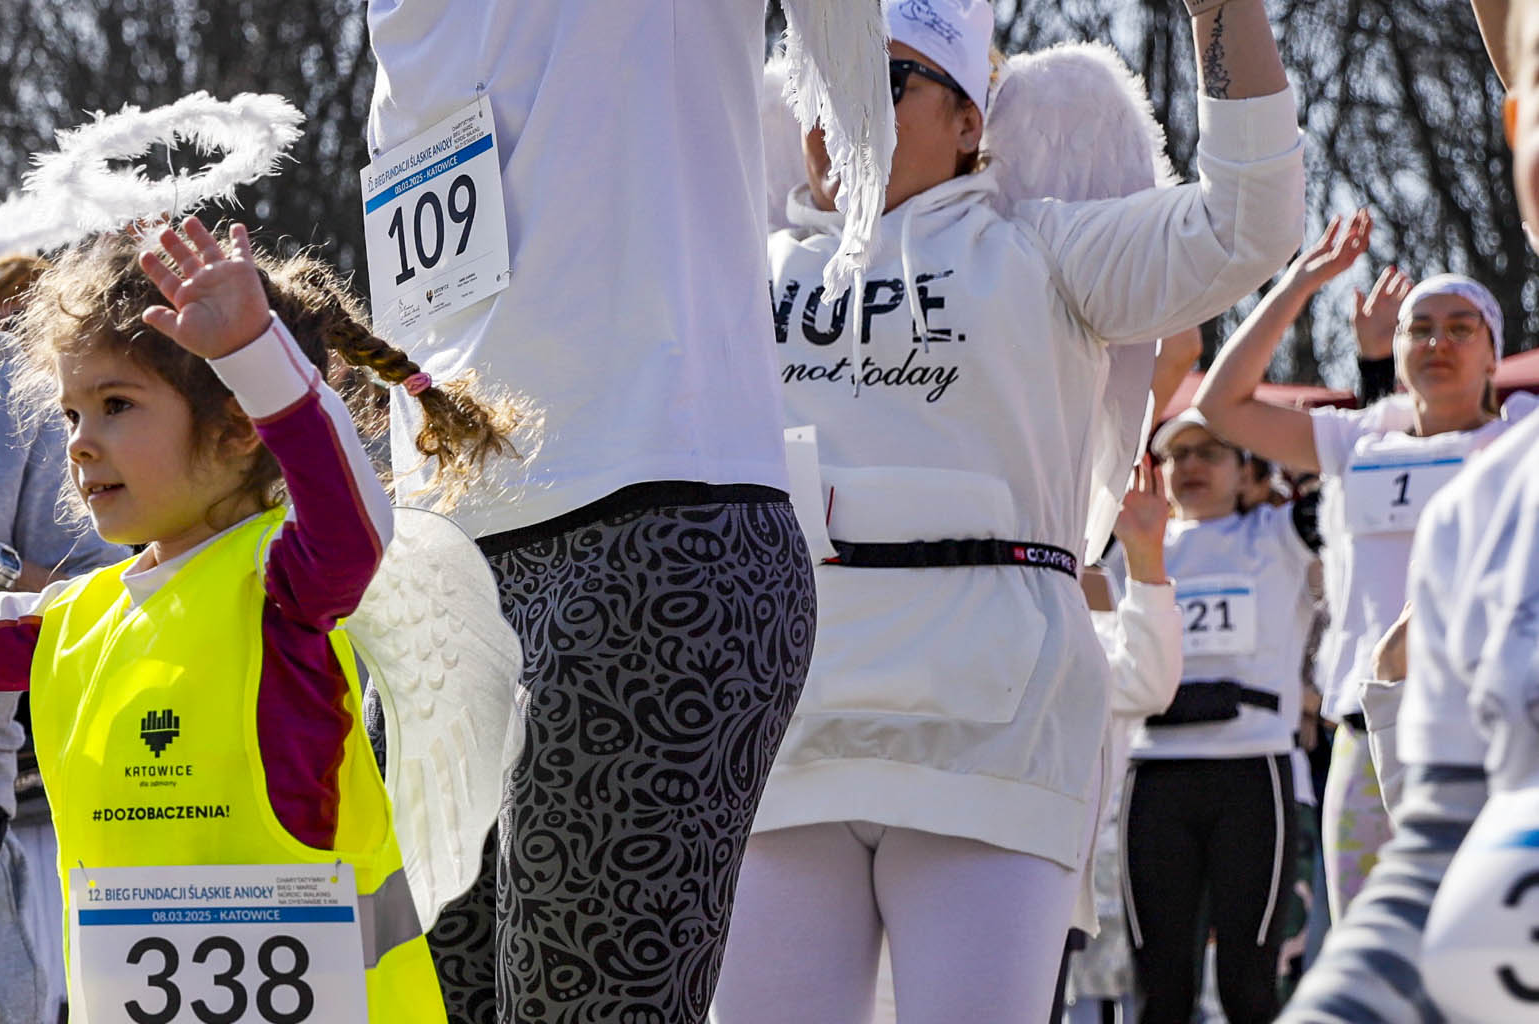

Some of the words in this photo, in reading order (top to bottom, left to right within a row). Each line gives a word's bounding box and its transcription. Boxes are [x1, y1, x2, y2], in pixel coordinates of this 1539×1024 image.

[375, 174, 385, 189] BIEG
[385, 159, 410, 181] FUNDACJI
[410, 146, 432, 170] ŚLĄSKIE
[432, 136, 453, 157] ANIOŁY
[394, 171, 424, 195] 08.03.2025
[426, 155, 459, 178] KATOWICE
[388, 174, 477, 286] 109
[782, 357, 851, 384] not
[851, 348, 959, 403] today
[1392, 472, 1410, 506] 1
[124, 765, 193, 777] KATOWICE
[93, 805, 230, 822] #DOZOBACZENIA!
[88, 888, 104, 901] 12.
[105, 887, 130, 901] BIEG
[132, 887, 187, 902] FUNDACJI
[188, 883, 232, 902] ŚLĄSKIE
[233, 886, 275, 900] ANIOŁY
[152, 909, 212, 922] 08.03.2025
[219, 909, 281, 922] KATOWICE
